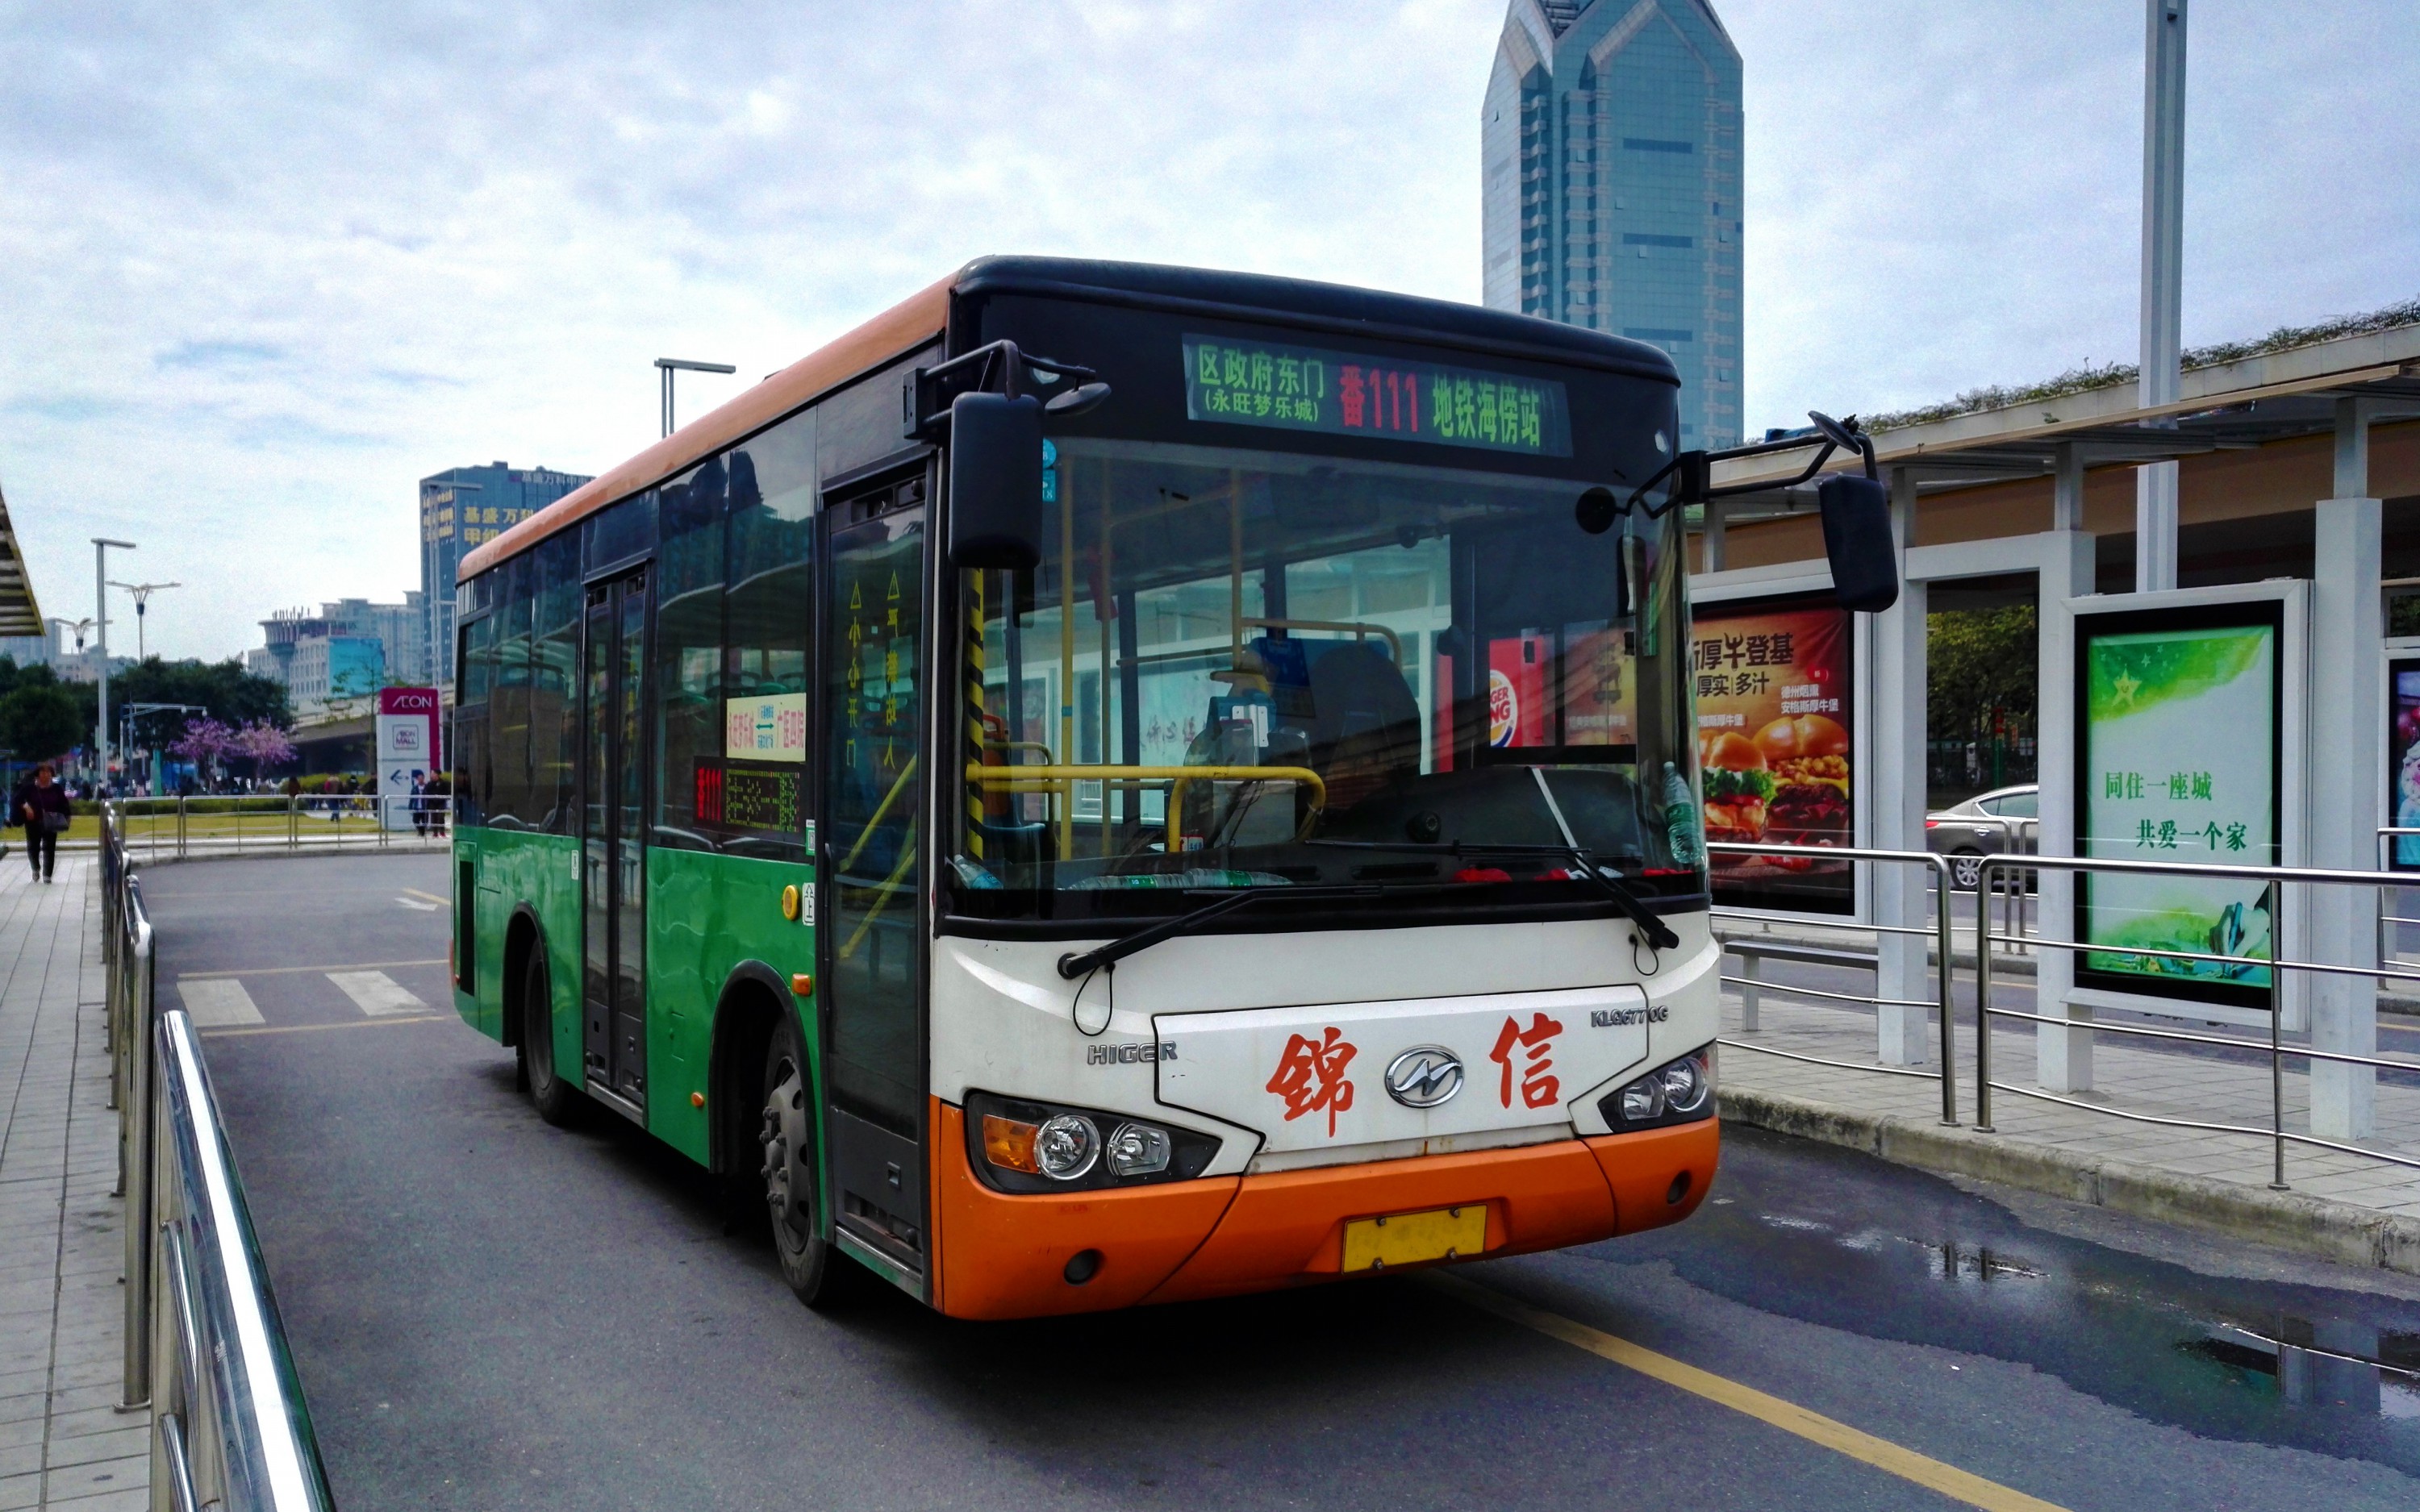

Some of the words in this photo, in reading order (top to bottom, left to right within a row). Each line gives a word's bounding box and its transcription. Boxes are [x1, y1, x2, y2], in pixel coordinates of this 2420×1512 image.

[1198, 344, 1324, 398] 区政府东门
[1340, 364, 1418, 433] 番111
[1433, 374, 1541, 447] 地铁海傍站
[1696, 674, 1729, 698] 厚实
[1735, 671, 1770, 696] 多汁
[1781, 698, 1839, 714] 安格斯厚牛堡
[2104, 771, 2213, 802] 同住一座城
[2134, 818, 2247, 852] 共爱一个家
[1590, 1006, 1669, 1027] KLQ6770G
[1087, 1040, 1178, 1065] HIGER
[1266, 1026, 1359, 1138] 錦
[1487, 1011, 1564, 1111] 信
